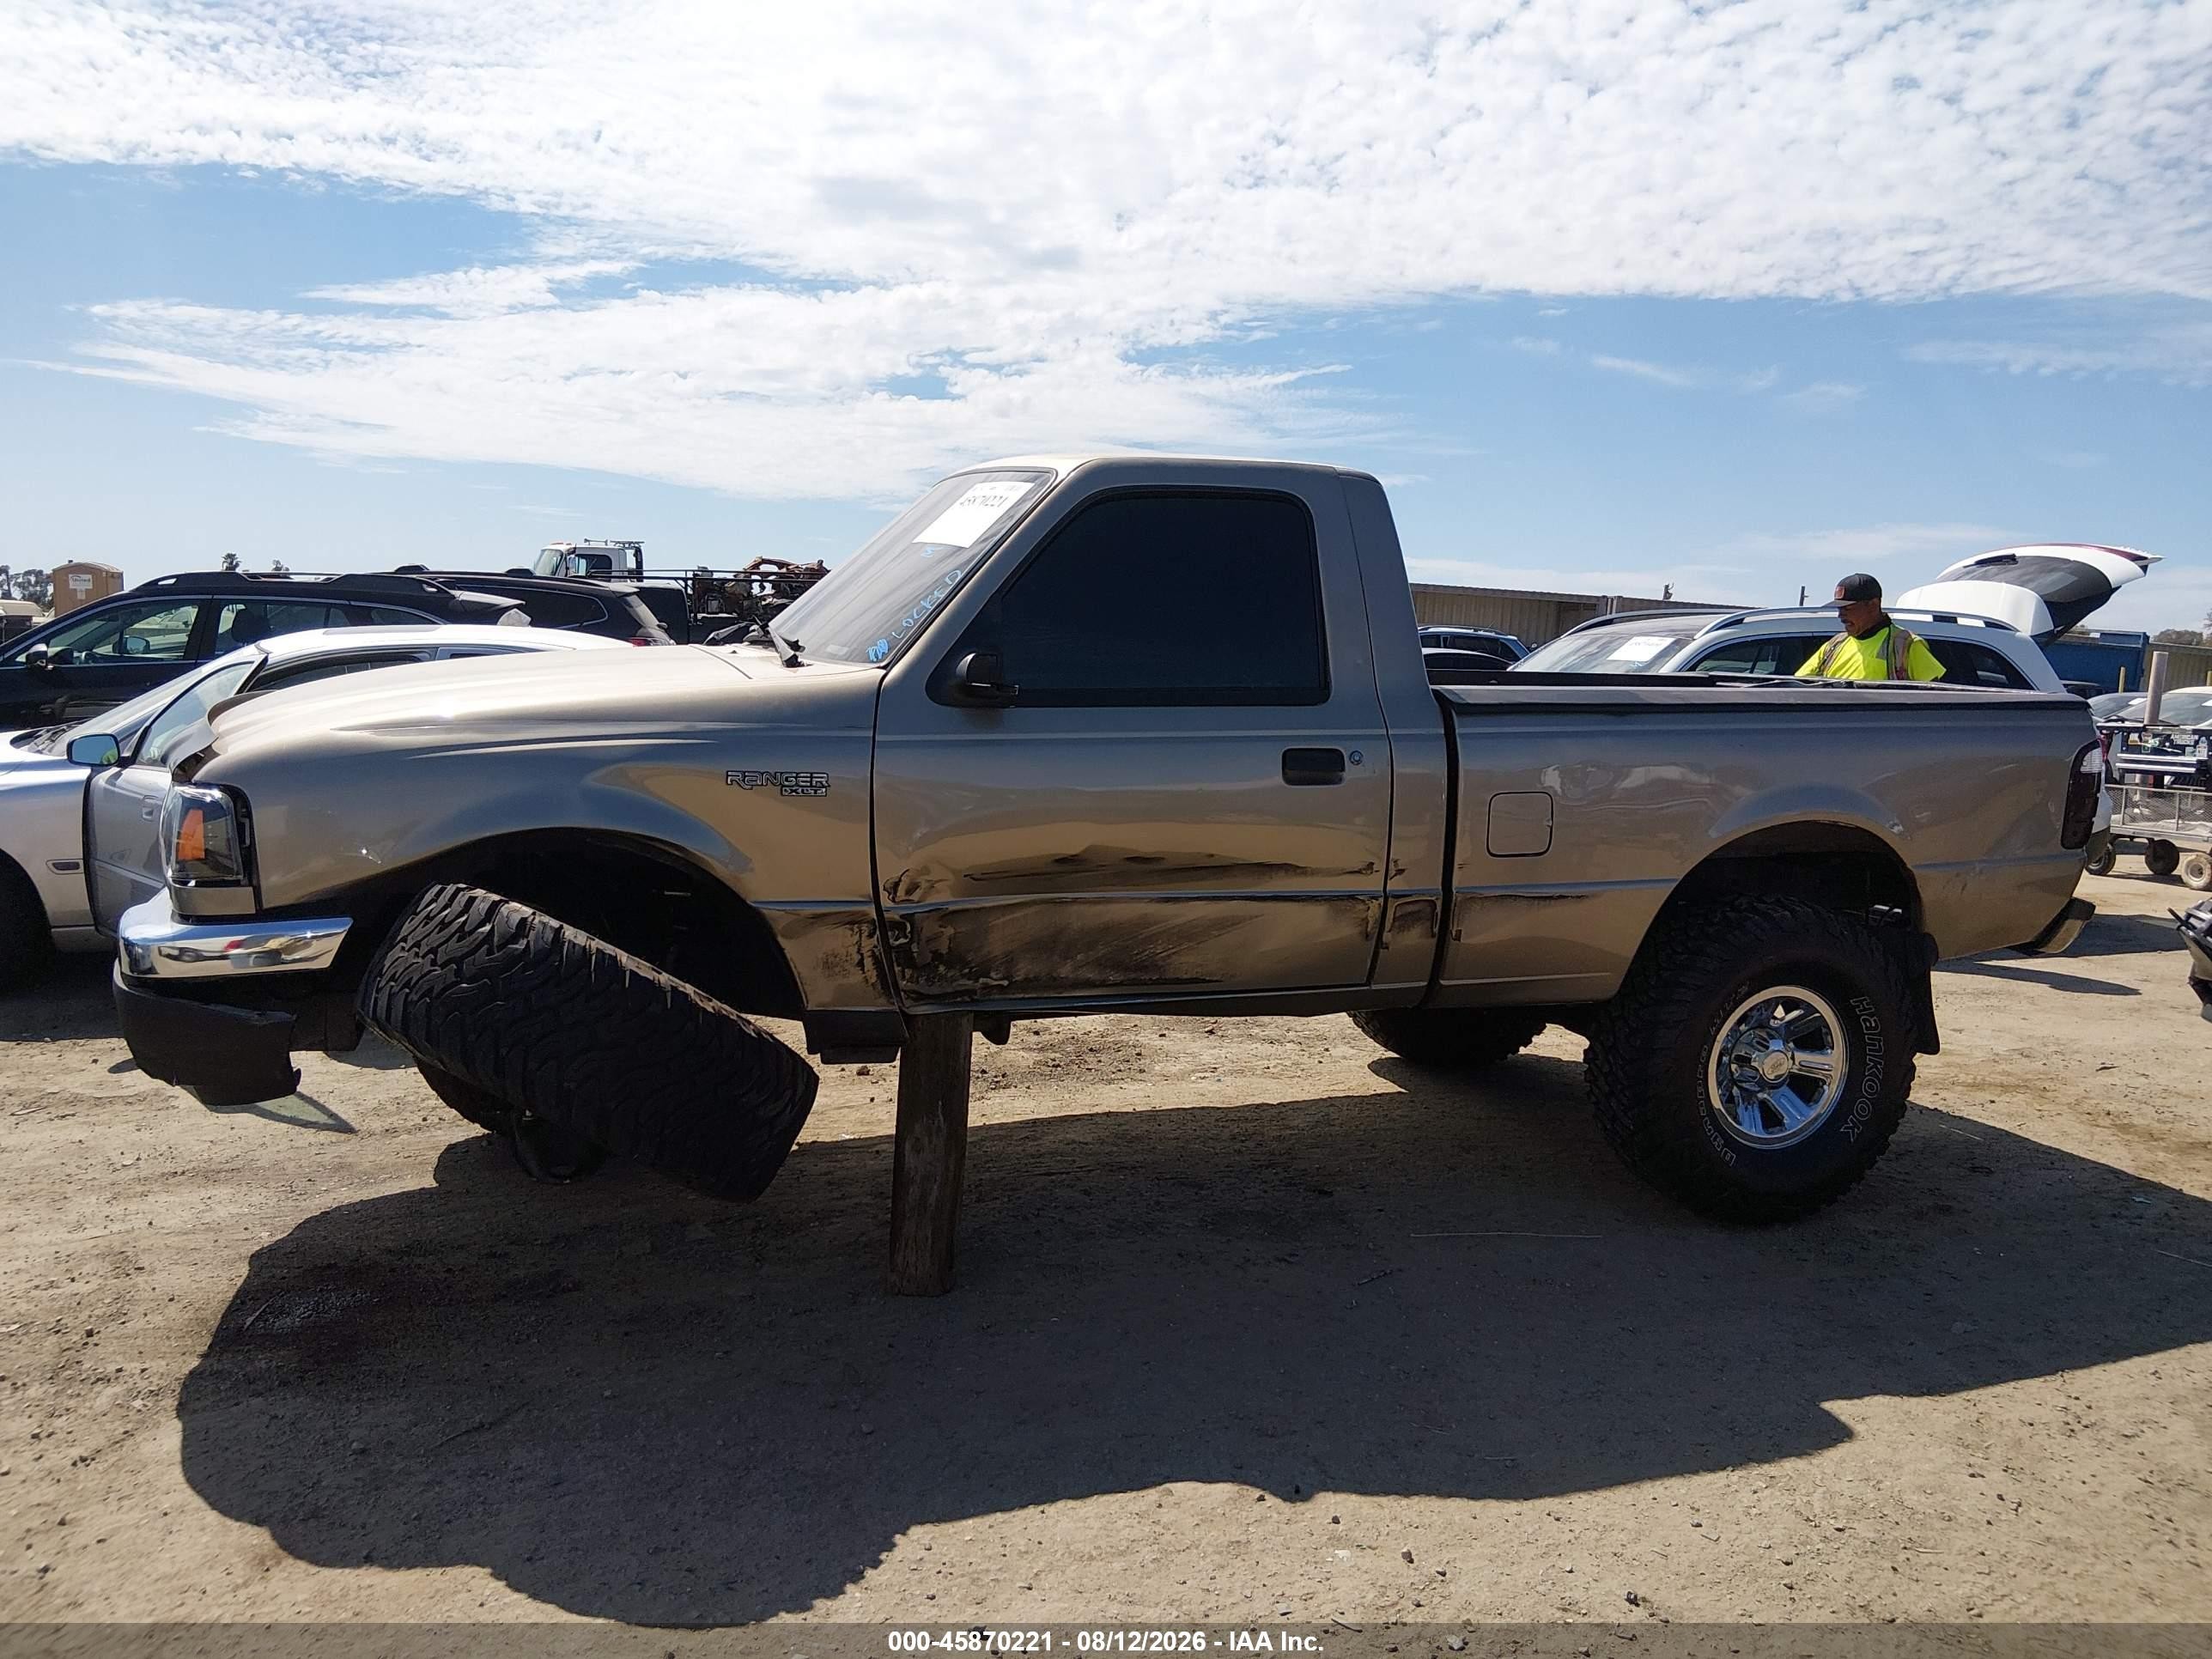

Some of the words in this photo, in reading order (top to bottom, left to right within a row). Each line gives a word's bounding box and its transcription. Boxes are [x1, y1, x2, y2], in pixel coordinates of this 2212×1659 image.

[959, 495, 1010, 507] 70221
[891, 568, 964, 639] LOCKED
[726, 770, 830, 790] RANGER
[781, 787, 827, 797] XLT
